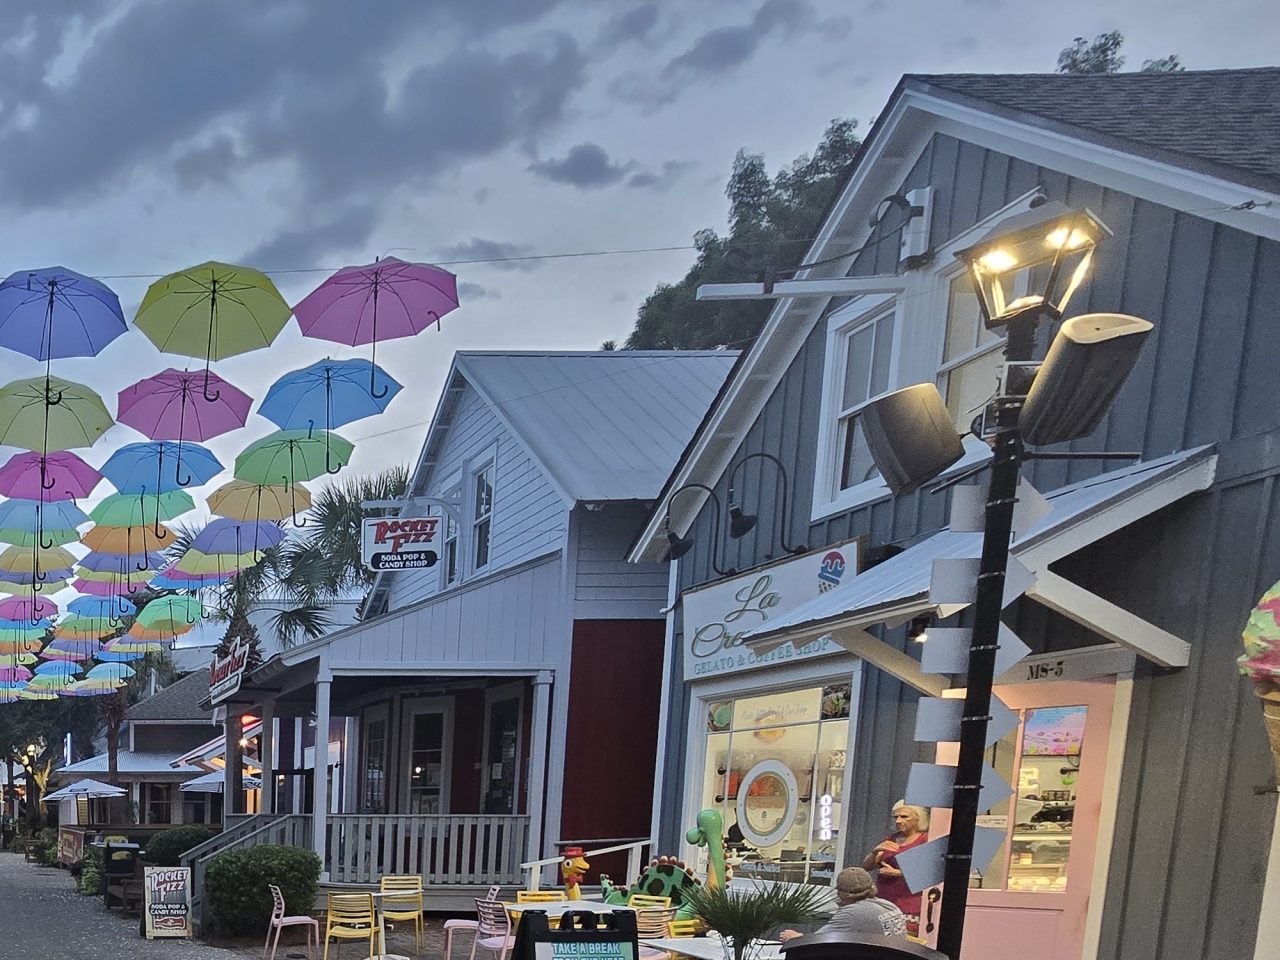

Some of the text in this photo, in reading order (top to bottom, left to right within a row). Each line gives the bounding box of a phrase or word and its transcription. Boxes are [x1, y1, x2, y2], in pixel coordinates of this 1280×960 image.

[368, 519, 439, 544] ROCKET
[386, 531, 436, 554] FIZZ
[379, 560, 428, 569] CANDY SHOP
[381, 552, 426, 562] SODA POP &
[724, 575, 782, 623] La
[694, 656, 734, 675] GELATO
[737, 654, 745, 666] &
[148, 870, 188, 891] ROCKET
[157, 881, 185, 902] FIZZ
[552, 943, 620, 954] TAKE A BREAK
